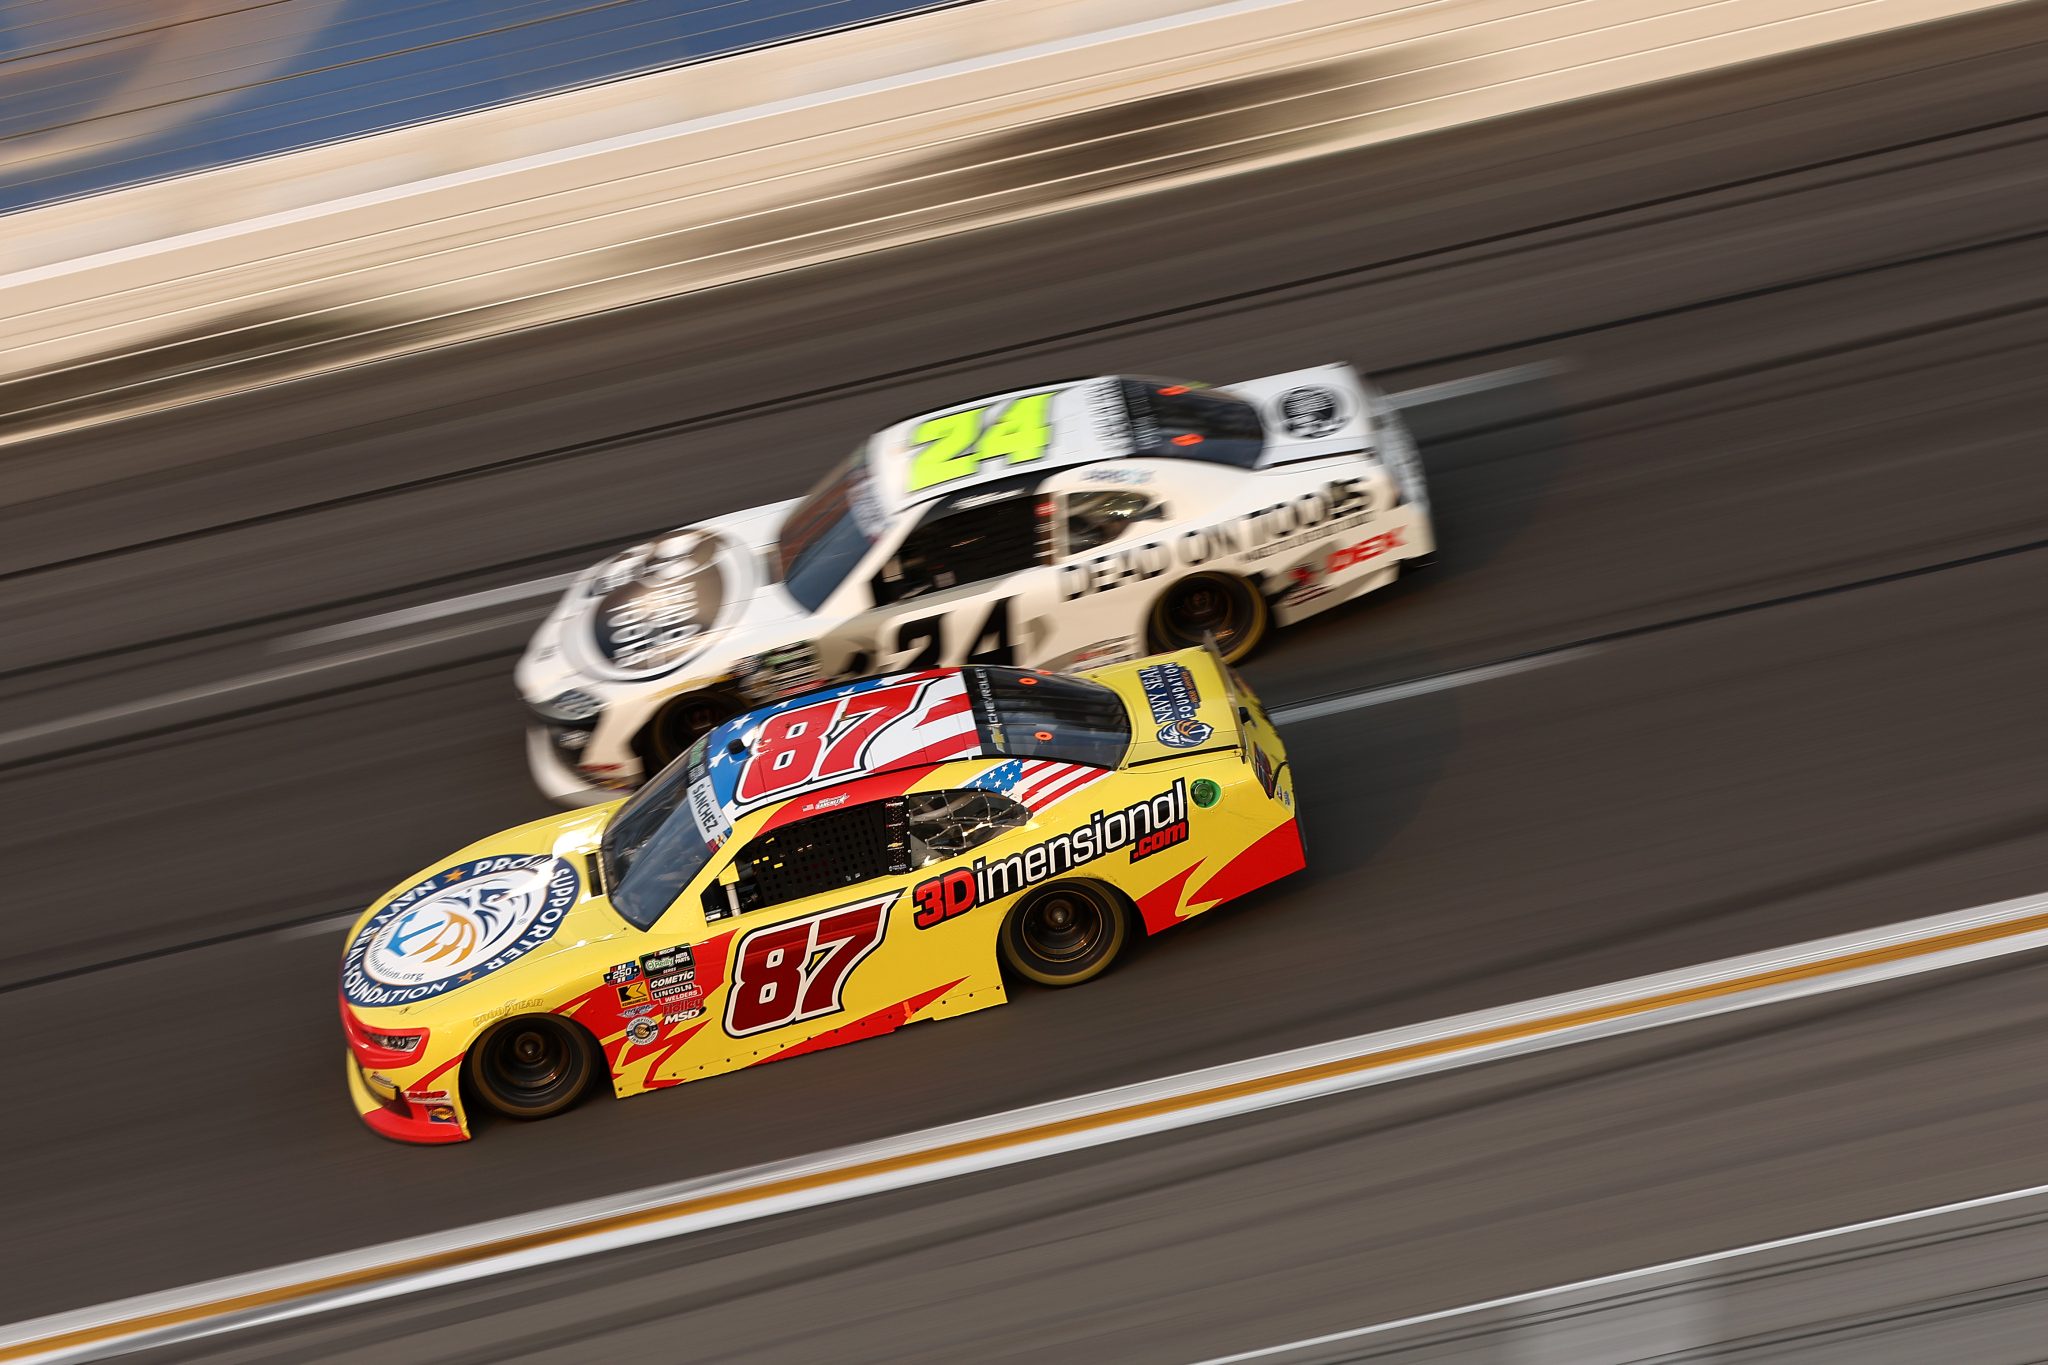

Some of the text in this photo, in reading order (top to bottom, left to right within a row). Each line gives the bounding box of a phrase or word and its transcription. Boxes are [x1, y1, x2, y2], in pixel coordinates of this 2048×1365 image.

[908, 391, 1056, 492] 24
[1059, 542, 1171, 601] DEAD
[1182, 520, 1239, 566] ON
[975, 668, 999, 723] CHEVROLET
[1140, 665, 1175, 724] NAVY SEAL
[1163, 661, 1195, 719] FOUNDATION
[736, 679, 938, 803] 87
[692, 784, 719, 833] SANCHEZ
[917, 780, 1184, 928] 3Dimensional
[1133, 821, 1186, 859] .com
[374, 880, 438, 926] NAVY
[472, 854, 576, 971] PRO SUPPORTER
[343, 963, 449, 1004] FOUNDATION
[612, 968, 632, 979] 250
[650, 970, 694, 988] COMETIC
[725, 892, 900, 1036] 87
[653, 983, 692, 998] LINCOLN
[665, 990, 698, 1002] WELDERS
[664, 1009, 700, 1025] MSD
